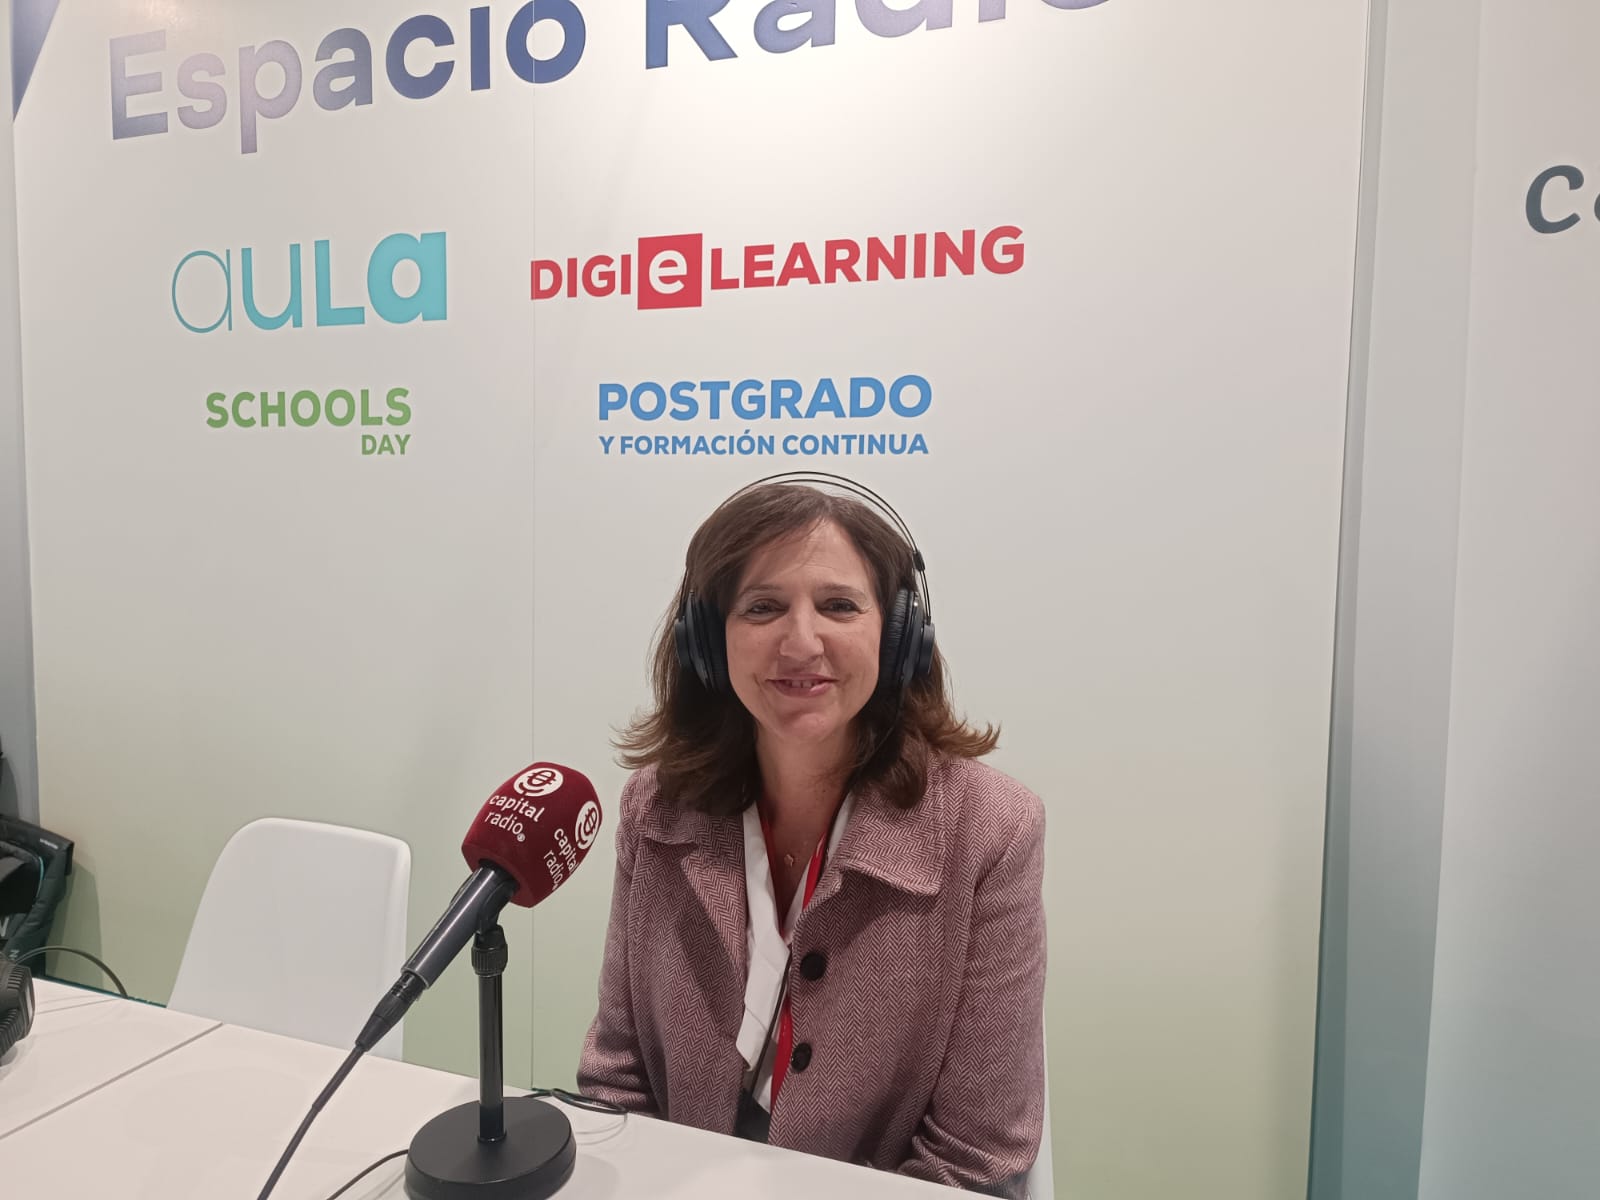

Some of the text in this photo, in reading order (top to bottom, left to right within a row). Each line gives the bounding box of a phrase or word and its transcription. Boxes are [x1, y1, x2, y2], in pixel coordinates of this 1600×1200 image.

[109, 0, 587, 155] Espacio
[206, 387, 412, 429] SCHOOLS
[598, 374, 933, 421] POSTGRADO
[360, 434, 412, 456] DAY
[599, 429, 930, 456] Y FORMACIÓN CONTINUA
[489, 795, 545, 823] capital
